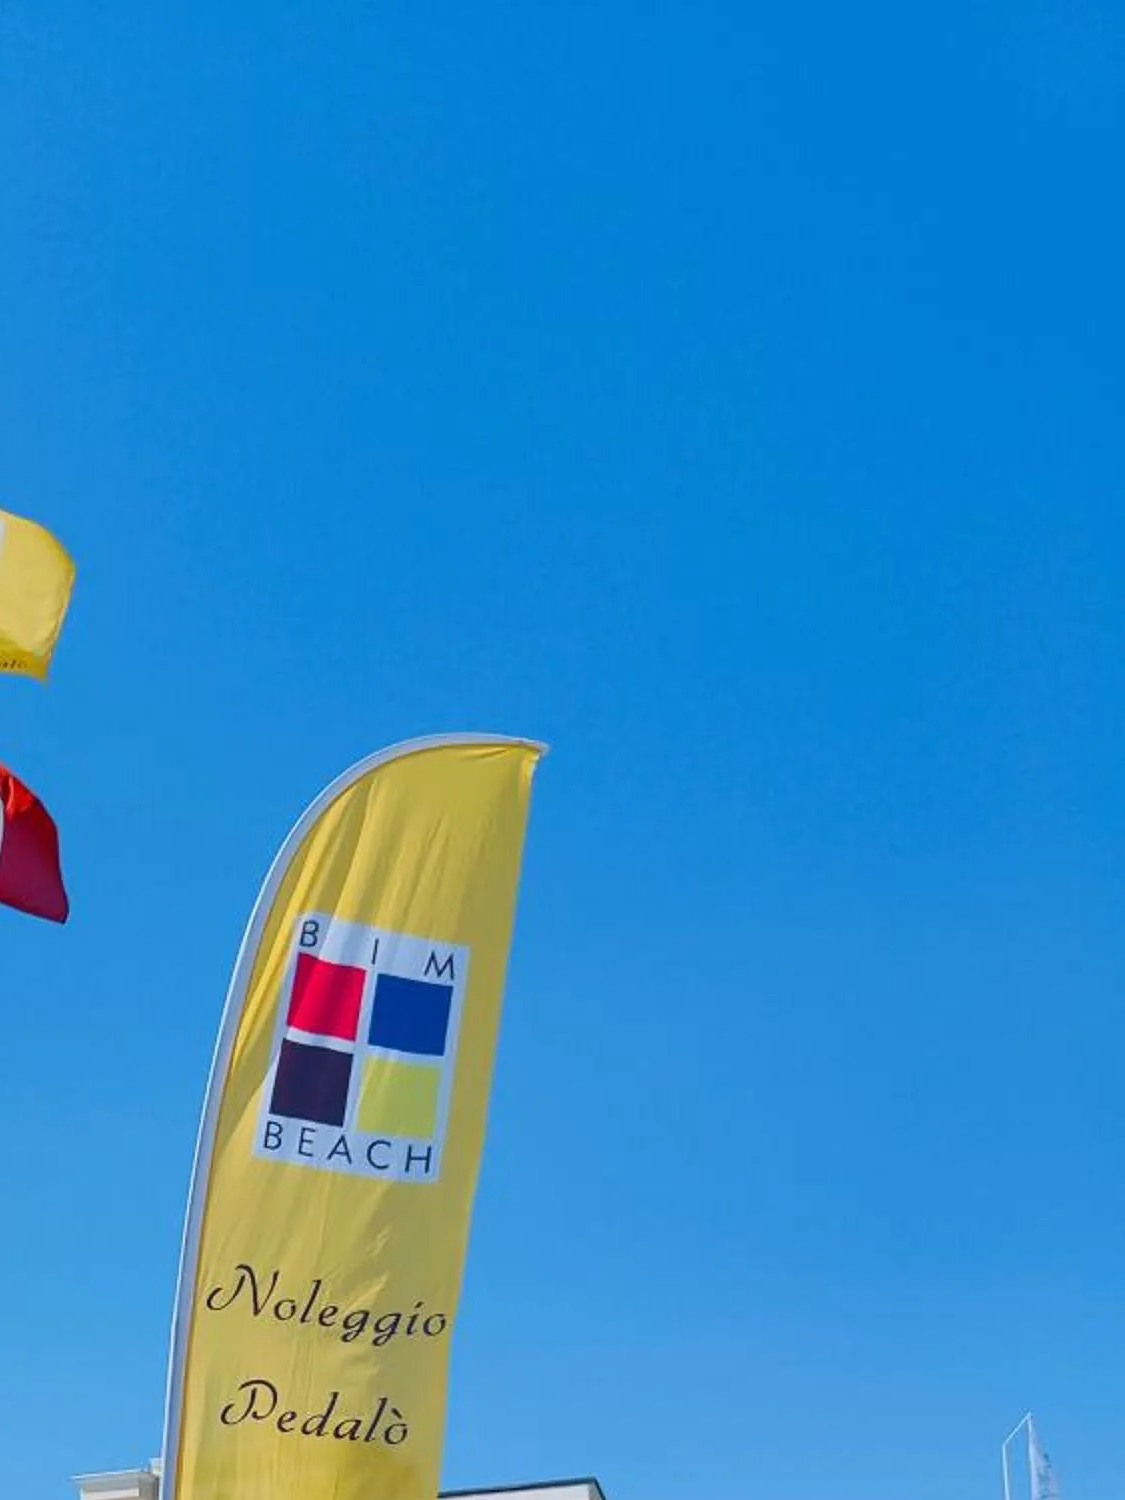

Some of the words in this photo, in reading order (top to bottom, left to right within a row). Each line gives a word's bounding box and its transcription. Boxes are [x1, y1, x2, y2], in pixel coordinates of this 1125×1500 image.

[298, 919, 455, 980] BIM
[263, 1121, 433, 1174] BEACH
[206, 1264, 447, 1347] Noleggio
[220, 1379, 408, 1445] Pedalò
